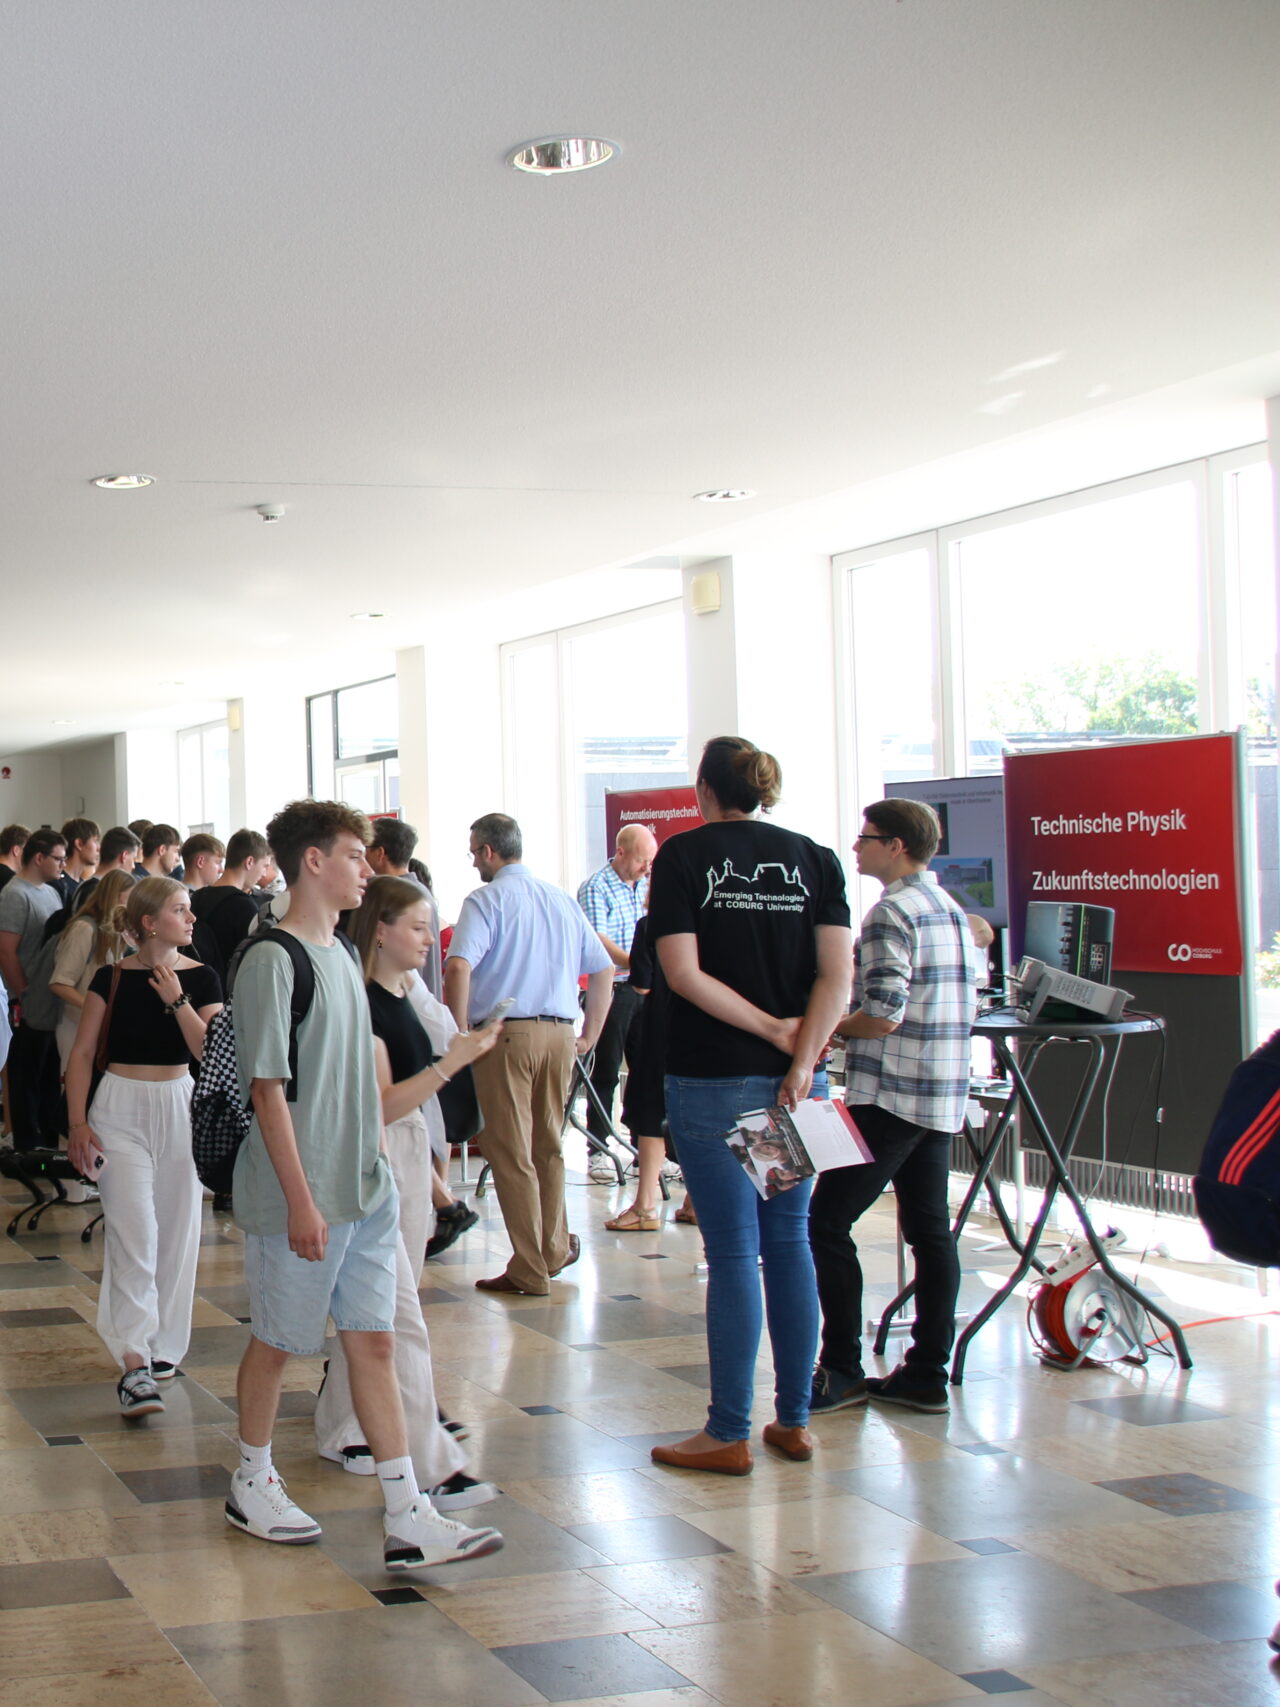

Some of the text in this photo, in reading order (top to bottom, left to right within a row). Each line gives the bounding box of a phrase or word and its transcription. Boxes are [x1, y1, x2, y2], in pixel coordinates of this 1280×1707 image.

[620, 805, 699, 821] Automatisierungstechnik
[1030, 808, 1187, 836] Technische Physik
[1032, 868, 1219, 895] Zukunftstechnologien
[713, 890, 805, 903] Emerging Technologies
[725, 901, 764, 910] COBURG
[767, 903, 804, 913] University
